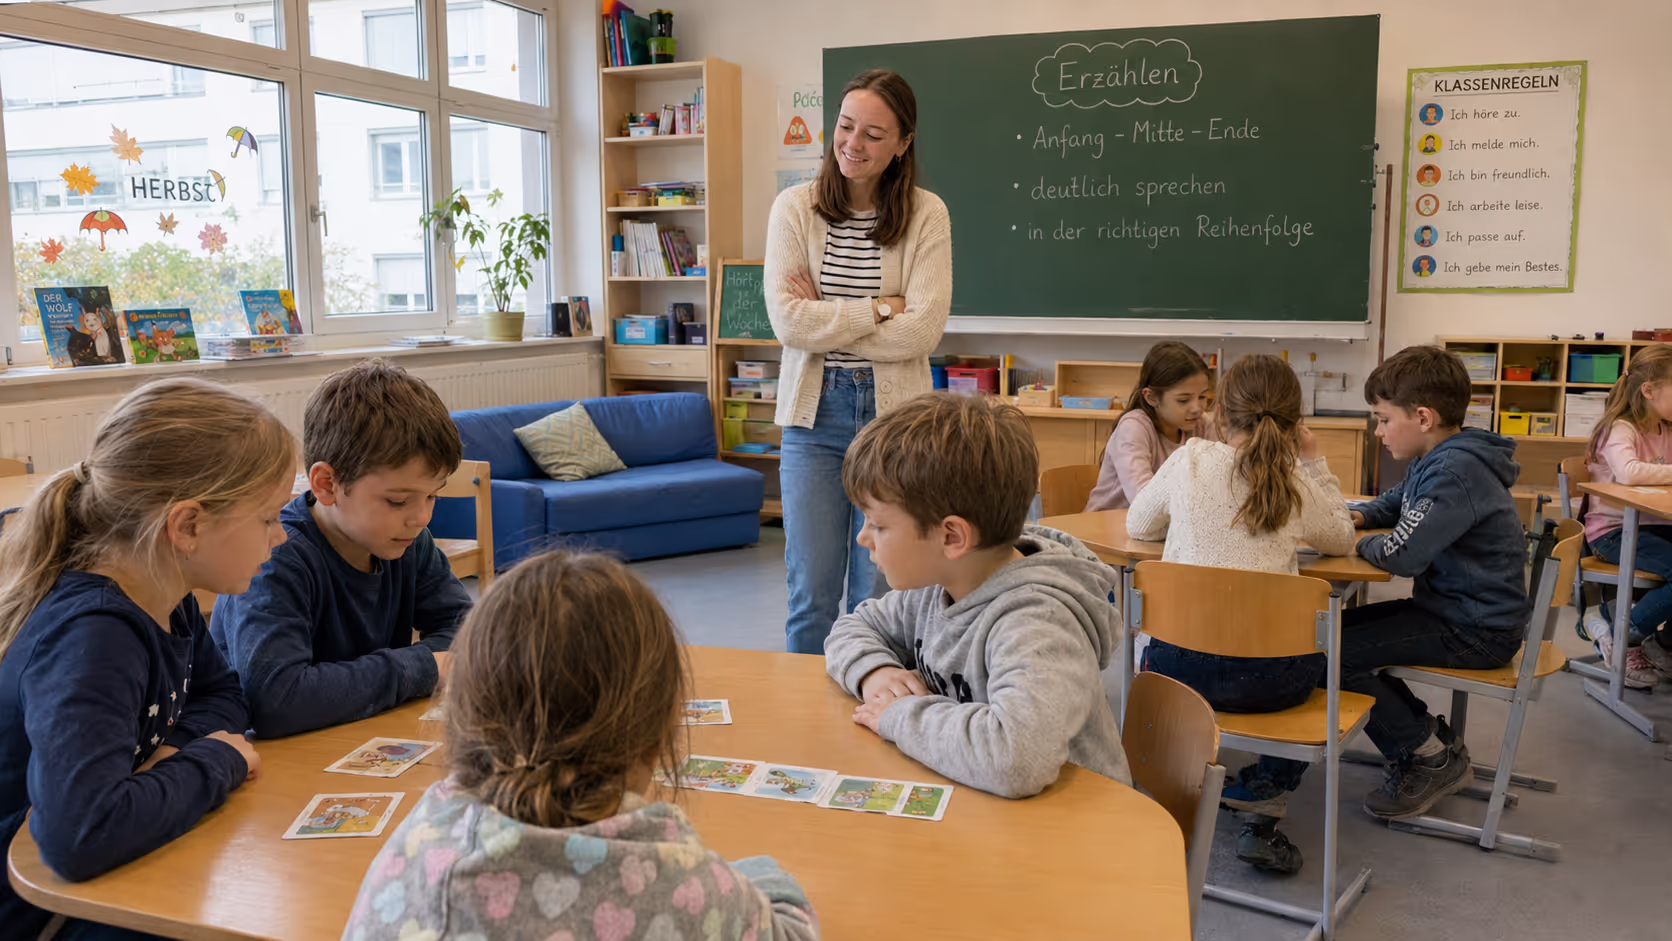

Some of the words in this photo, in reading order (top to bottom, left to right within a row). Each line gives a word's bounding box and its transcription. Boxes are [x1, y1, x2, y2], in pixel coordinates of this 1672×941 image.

[1059, 58, 1180, 91] Erzählen
[1433, 75, 1560, 93] KLASSENREGELN
[1450, 108, 1468, 121] Ich
[1473, 108, 1499, 120] höre
[1503, 110, 1521, 119] zu.
[1033, 124, 1104, 159] Anfang
[1132, 120, 1185, 144] Mitte
[1208, 118, 1260, 140] Ende
[1448, 139, 1466, 151] Ich
[1471, 138, 1503, 150] melde
[1509, 137, 1539, 149] mich.
[1447, 170, 1465, 182] Ich
[1470, 169, 1488, 181] bin
[1492, 167, 1551, 183] freundlich.
[131, 176, 216, 203] HERBST
[1031, 175, 1120, 200] deutlich
[1136, 174, 1226, 205] sprechen
[1446, 200, 1465, 212] Ich
[1469, 199, 1510, 211] arbeite
[1515, 199, 1543, 211] leise.
[1028, 222, 1043, 241] in
[1052, 219, 1086, 240] der
[1097, 217, 1180, 249] richtigen
[1196, 214, 1314, 247] Reihenfolge
[1445, 230, 1463, 242] Ich
[1467, 233, 1499, 246] passe
[1503, 230, 1526, 242] auf.
[1443, 261, 1461, 273] Ich
[1465, 262, 1492, 276] gebe
[1495, 261, 1521, 273] mein
[1525, 260, 1563, 273] Bestes.
[43, 293, 63, 303] DER
[46, 303, 73, 313] WOLF
